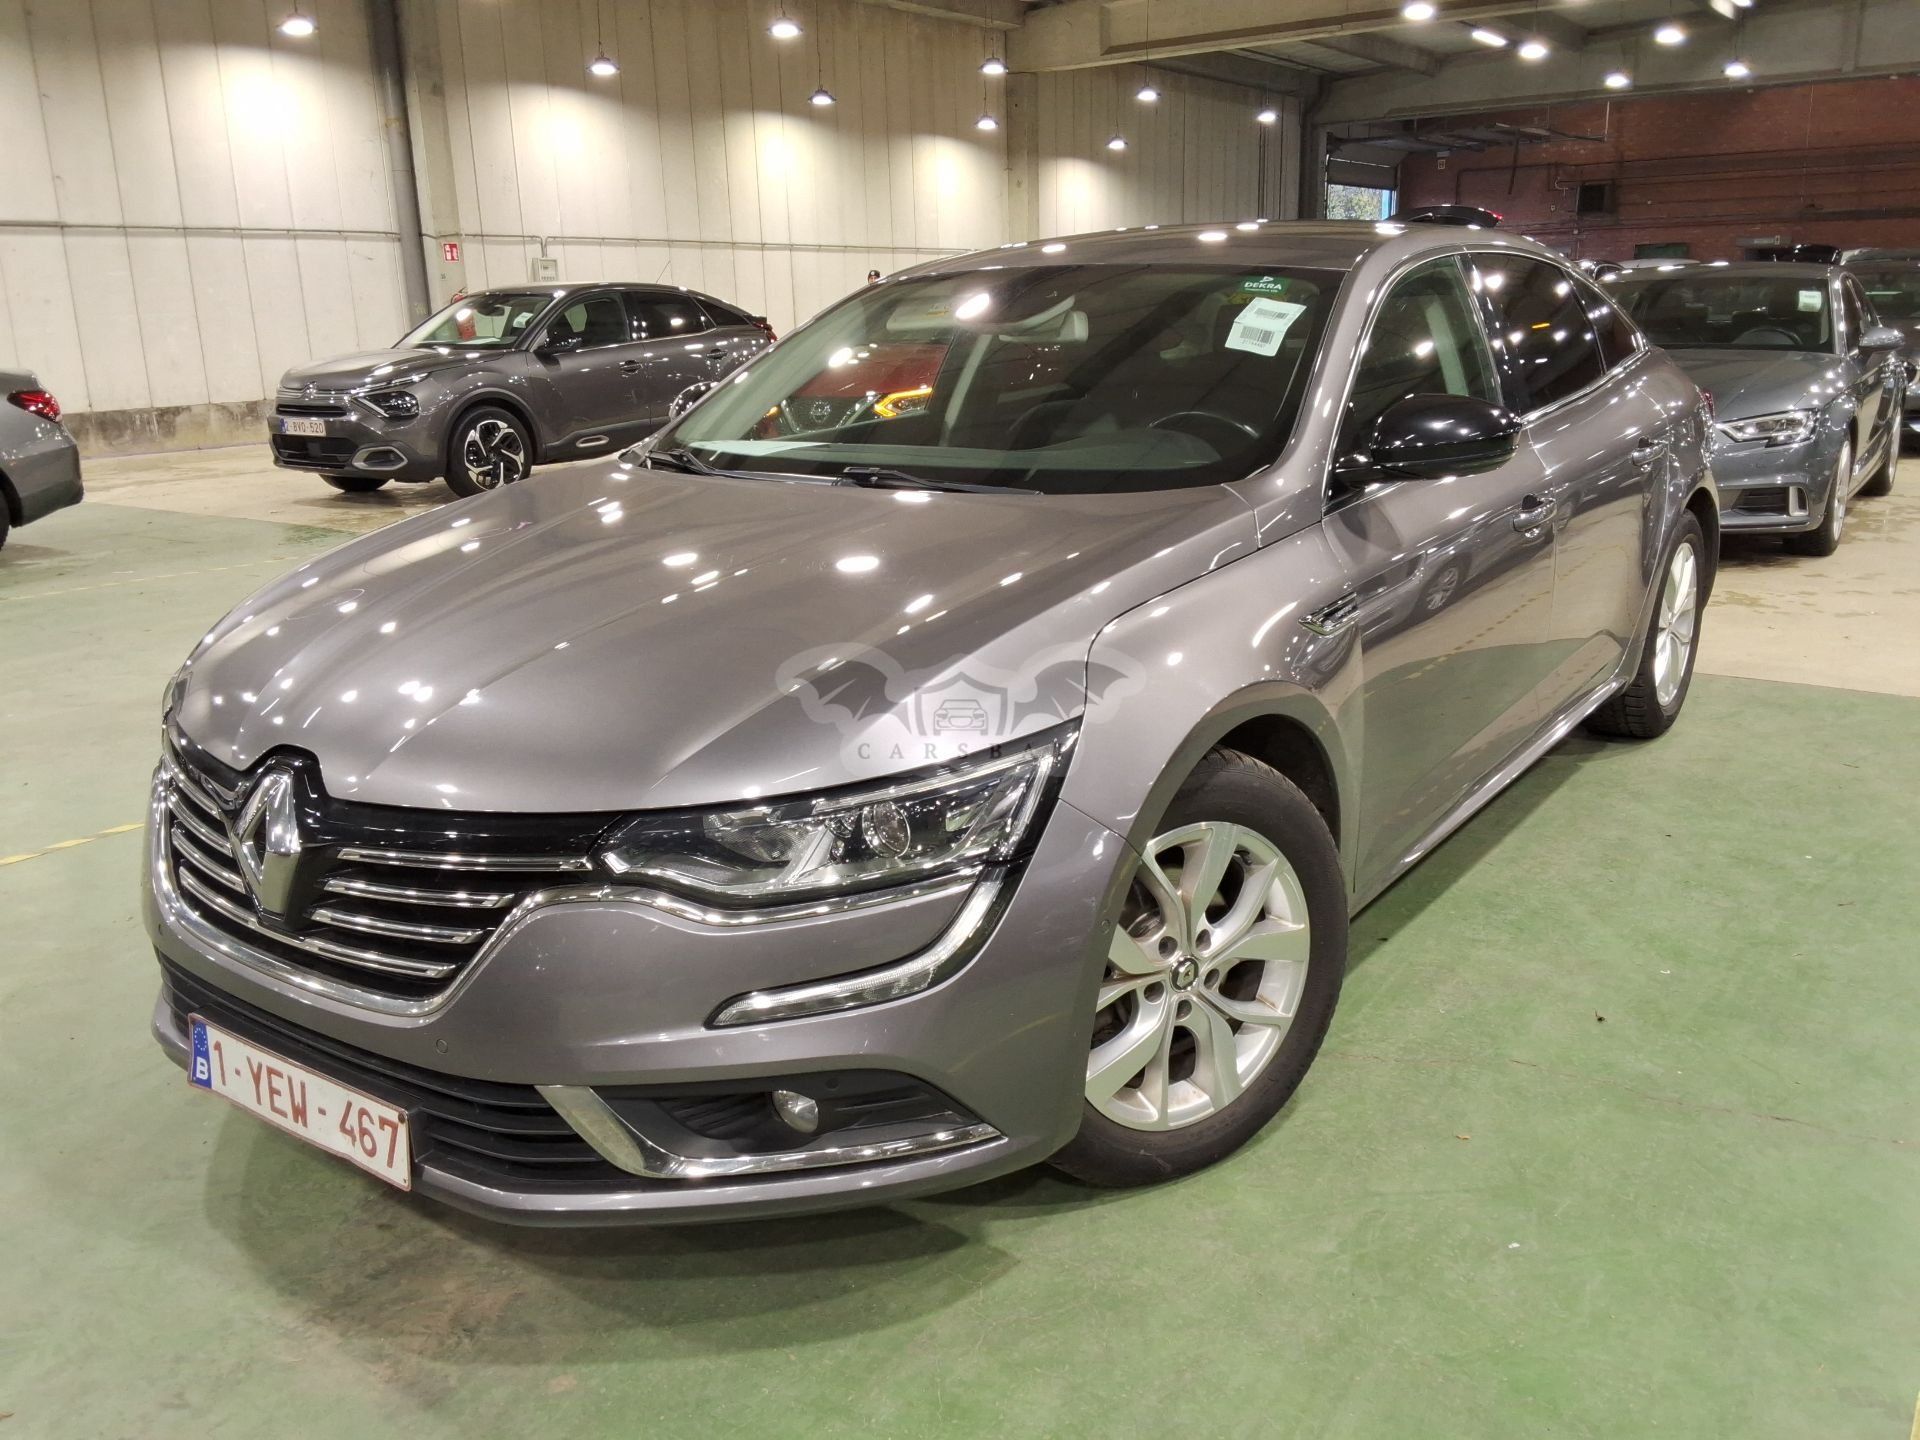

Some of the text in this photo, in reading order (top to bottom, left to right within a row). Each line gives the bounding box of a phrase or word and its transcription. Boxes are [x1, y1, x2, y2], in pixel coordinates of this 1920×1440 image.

[1244, 282, 1282, 290] DEKRA
[196, 1056, 209, 1080] B
[213, 1039, 399, 1169] 1-YEW-467
